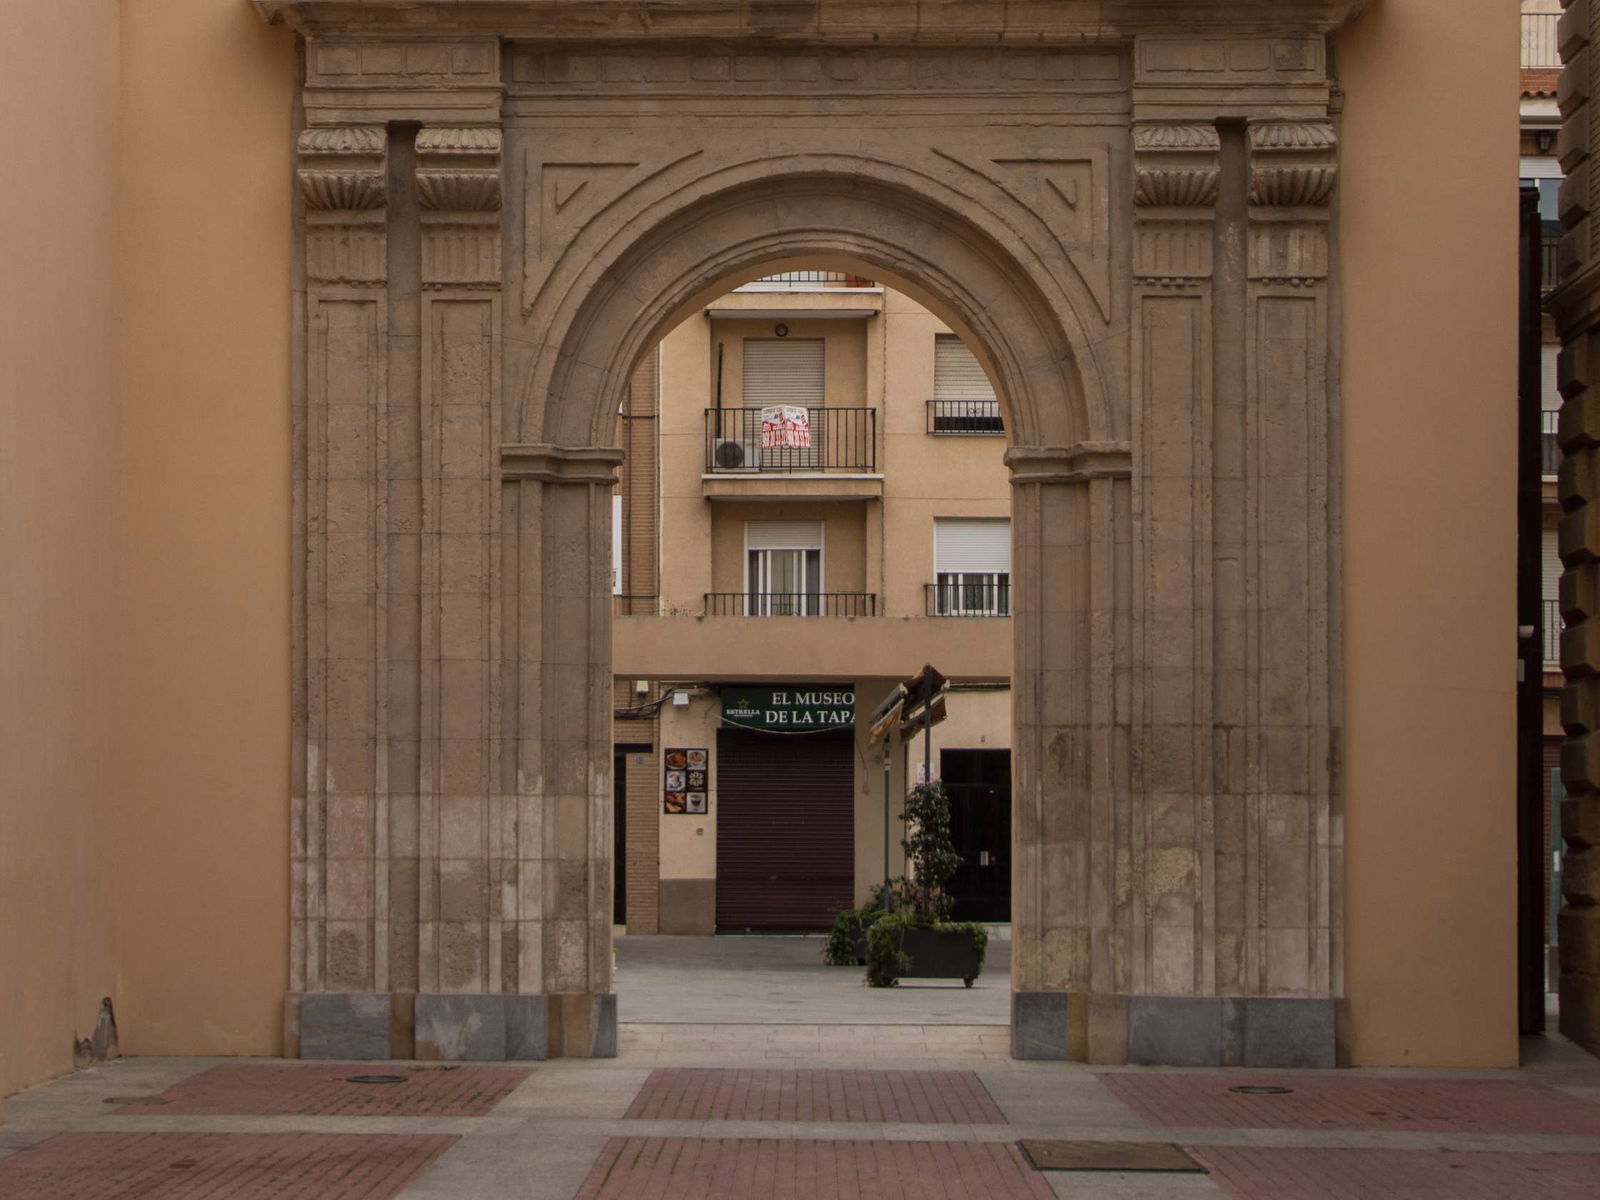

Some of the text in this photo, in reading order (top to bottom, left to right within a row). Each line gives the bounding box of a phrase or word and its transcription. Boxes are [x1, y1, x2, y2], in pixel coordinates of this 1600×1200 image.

[772, 692, 856, 705] EL MUSEO
[765, 711, 788, 723] DE
[792, 711, 814, 723] LA
